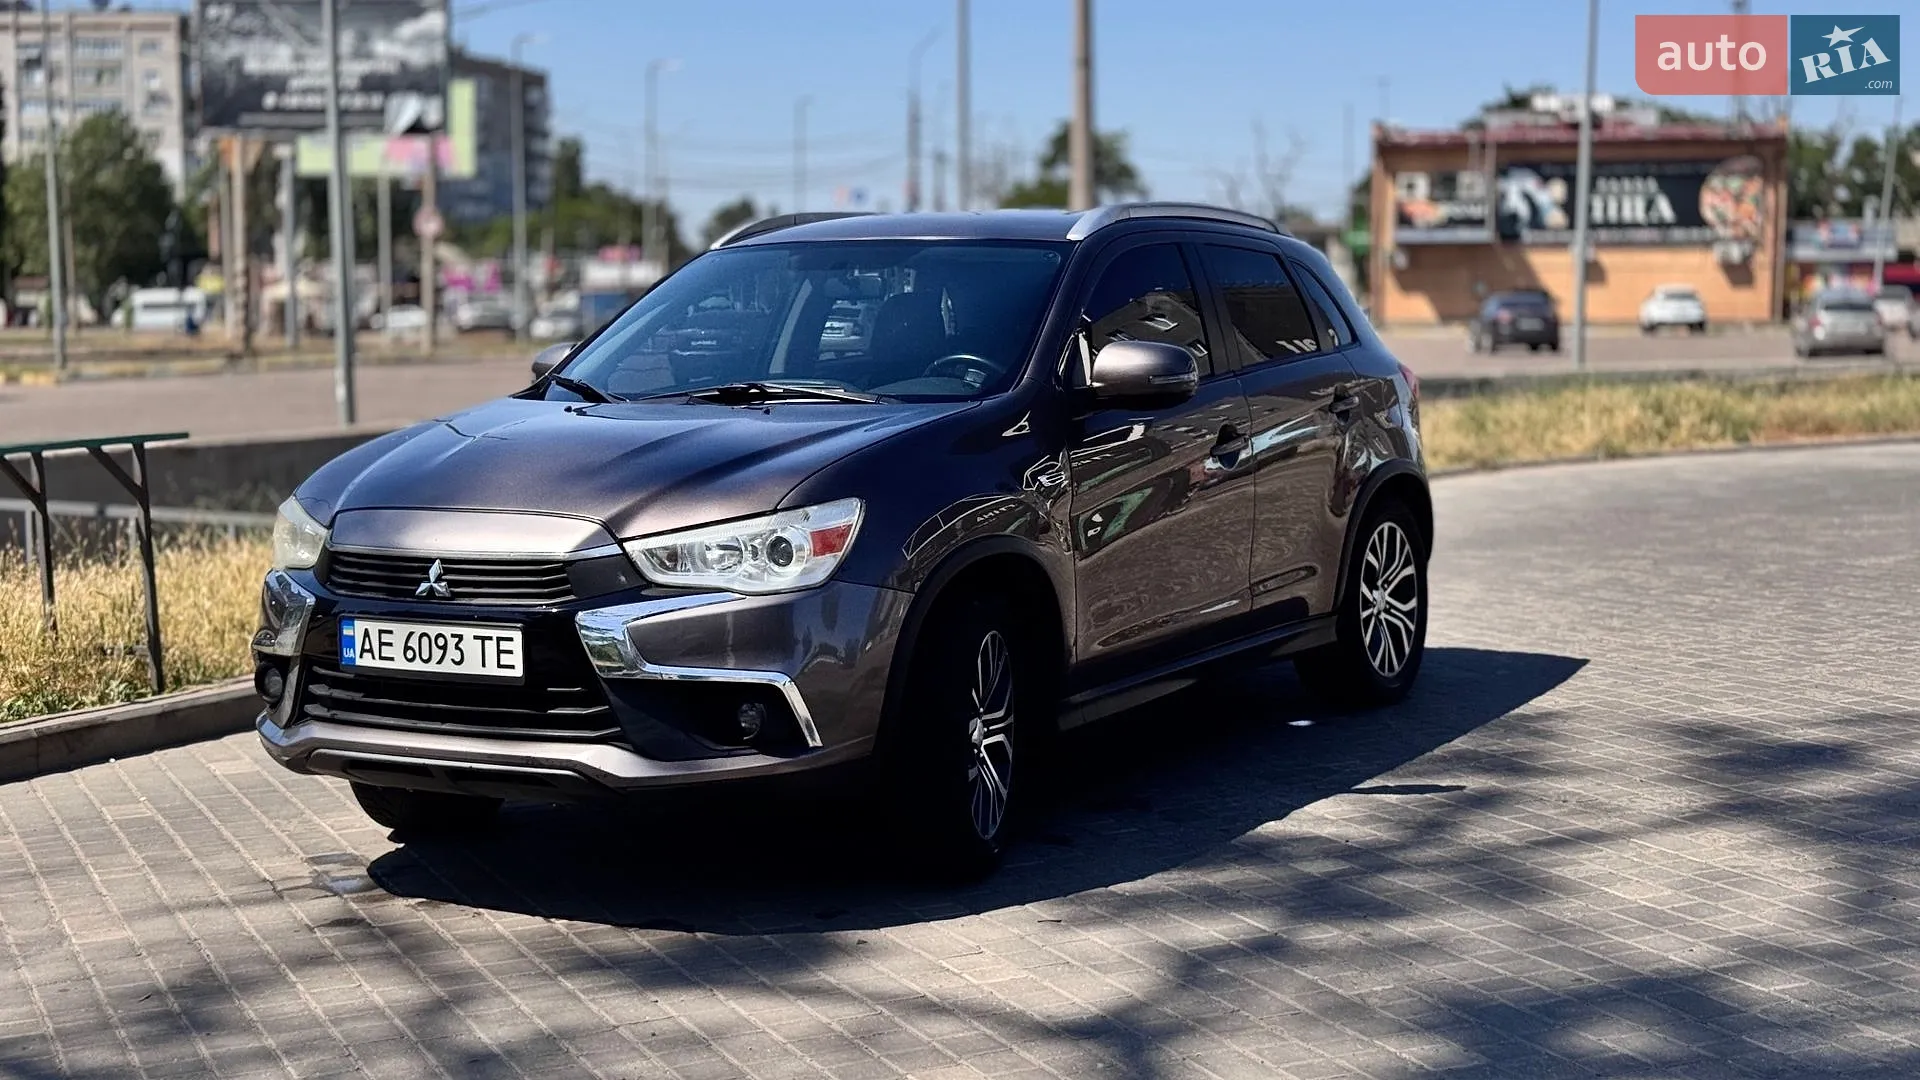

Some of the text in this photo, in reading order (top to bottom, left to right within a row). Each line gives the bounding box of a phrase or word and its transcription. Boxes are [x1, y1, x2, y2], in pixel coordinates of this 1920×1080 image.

[343, 648, 355, 659] UA
[359, 627, 516, 670] AE 6093 TE
